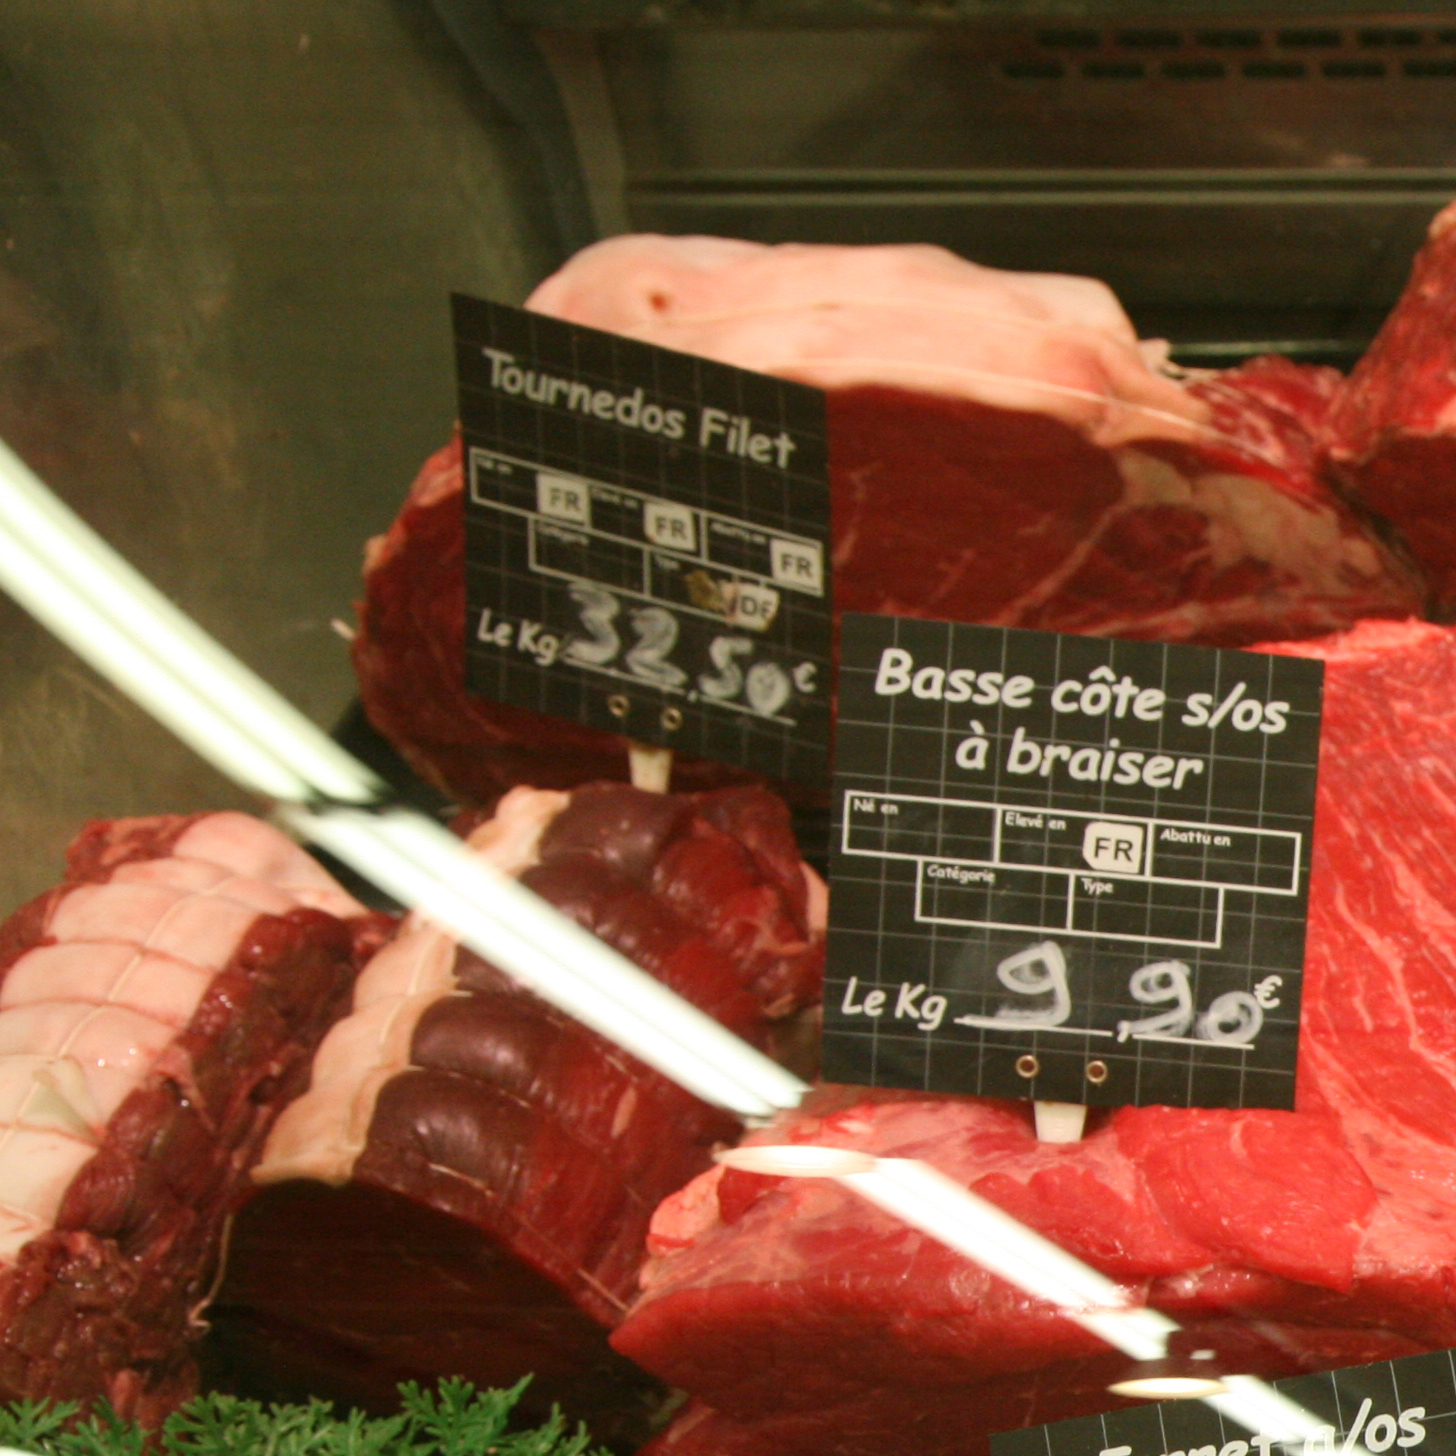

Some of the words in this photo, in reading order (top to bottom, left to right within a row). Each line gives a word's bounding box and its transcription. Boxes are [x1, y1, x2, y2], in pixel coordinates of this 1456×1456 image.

[483, 347, 687, 439] Tournedos
[700, 407, 797, 469] Filet
[549, 486, 581, 513] FR
[655, 516, 688, 542] FR
[780, 553, 814, 578] FR
[478, 608, 510, 647] Le
[517, 620, 559, 666] Kg
[875, 648, 1035, 709] Basse
[1051, 665, 1166, 721] côte
[1181, 682, 1291, 734] s/os
[955, 720, 988, 771] à
[1006, 727, 1204, 790] braiser
[881, 804, 898, 817] en
[1049, 818, 1067, 831] en
[1093, 836, 1133, 862] FR
[1160, 828, 1211, 846] Abattu
[1213, 835, 1231, 848] en
[927, 864, 996, 884] Catégorie
[1081, 878, 1114, 896] Type
[841, 976, 885, 1018] Le
[895, 982, 947, 1031] Kg
